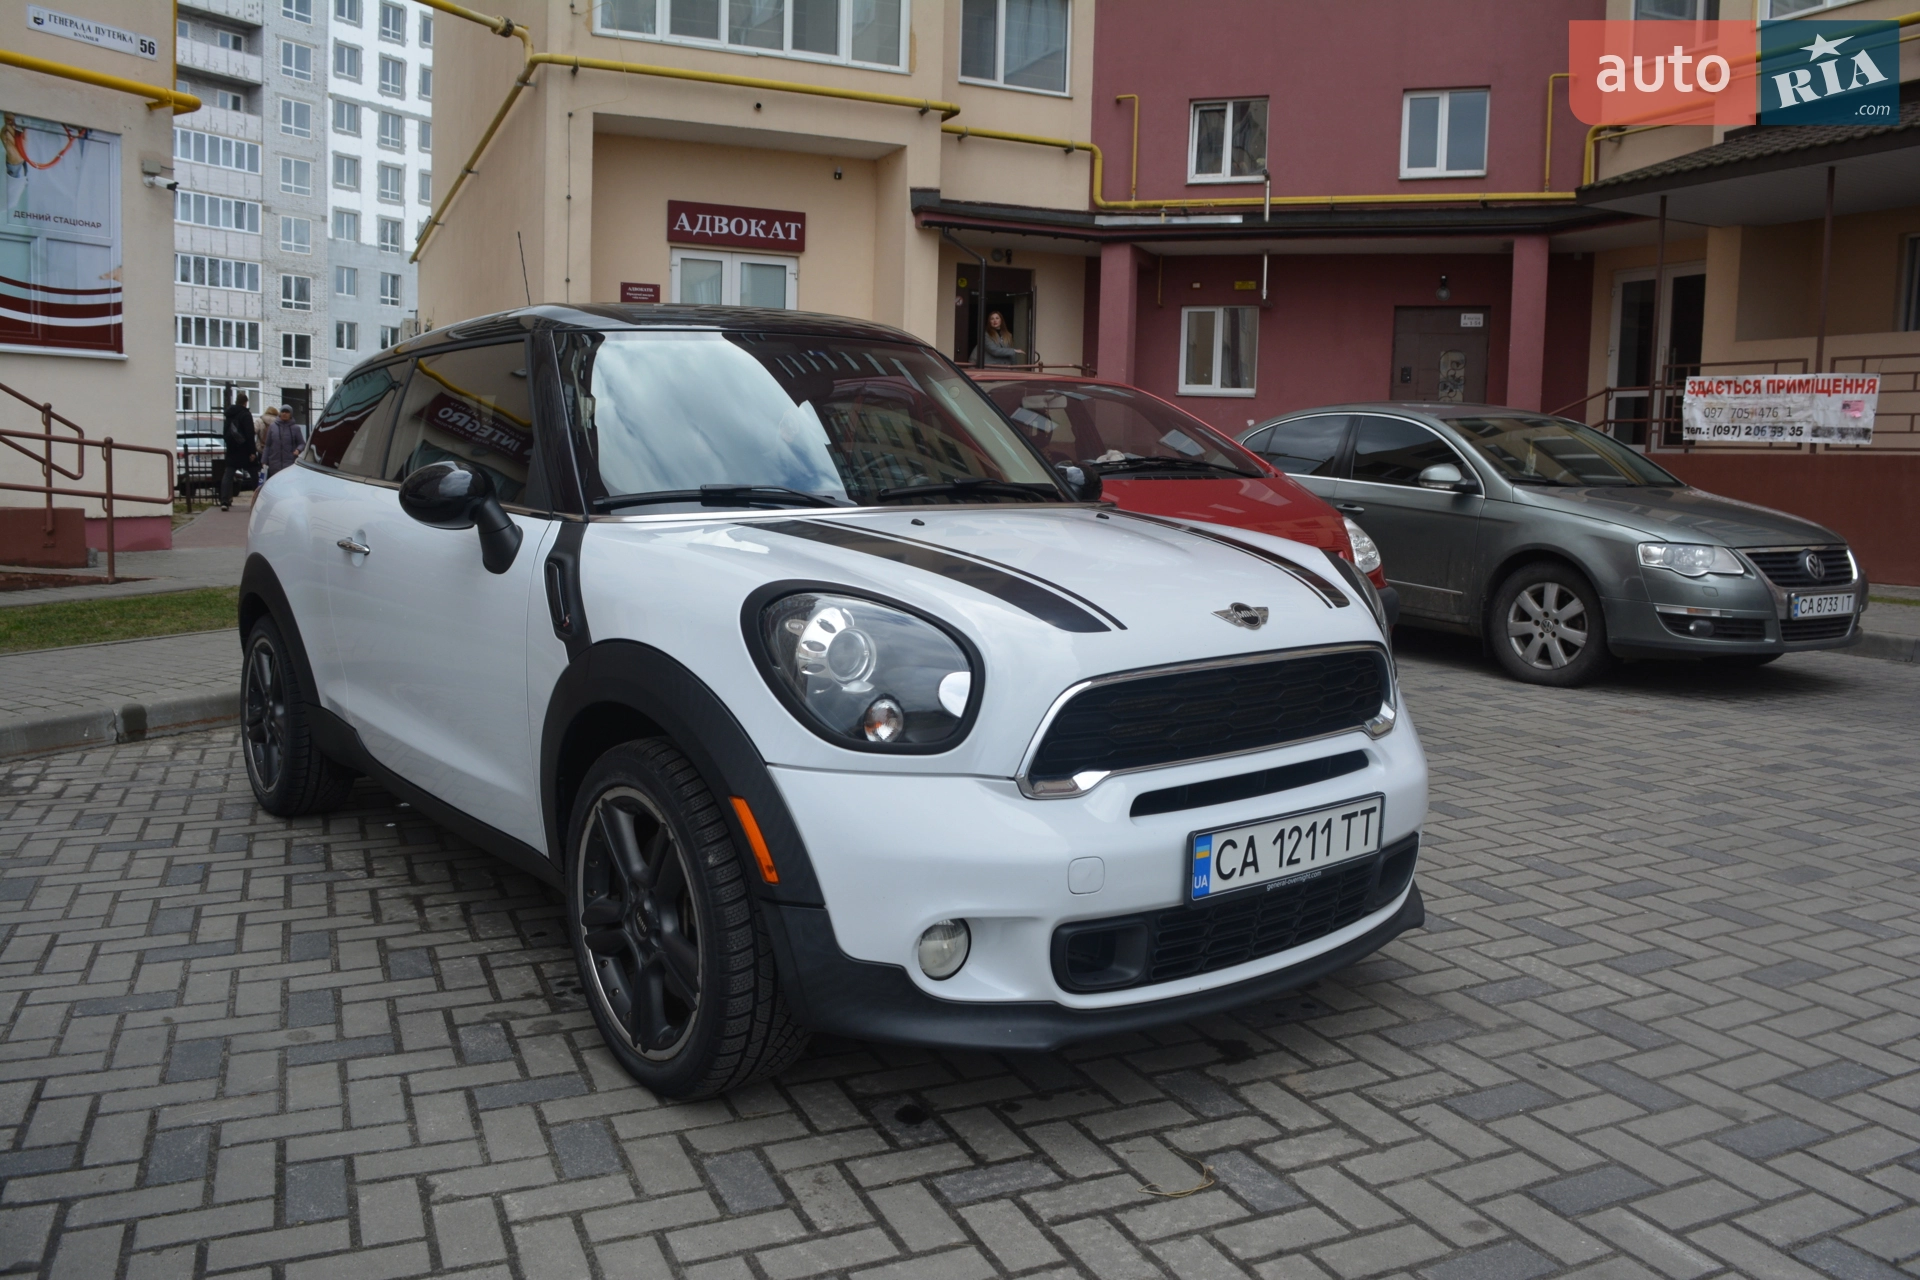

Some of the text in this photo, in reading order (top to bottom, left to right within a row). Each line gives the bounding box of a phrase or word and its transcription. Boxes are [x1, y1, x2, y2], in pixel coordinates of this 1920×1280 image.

[48, 13, 134, 44] ГЕНЕРАЛА ПУТЕЙКА
[139, 39, 156, 56] 56
[13, 210, 102, 229] ДЕННИЙ СТАЦІОНАР
[673, 212, 801, 241] АДВОКАТ
[1687, 378, 1878, 397] ЗДАЄТЬСЯ ПРИМІЩЕННЯ
[1703, 406, 1793, 418] 097 705 476 1
[1685, 427, 1710, 435] тел.:
[1712, 424, 1741, 437] (097)
[1788, 426, 1804, 437] 35
[1800, 595, 1852, 614] CA 8733 IT
[1215, 806, 1377, 880] CA 1211 TT
[1194, 874, 1208, 889] UA
[1266, 870, 1322, 891] general-overnight.com
